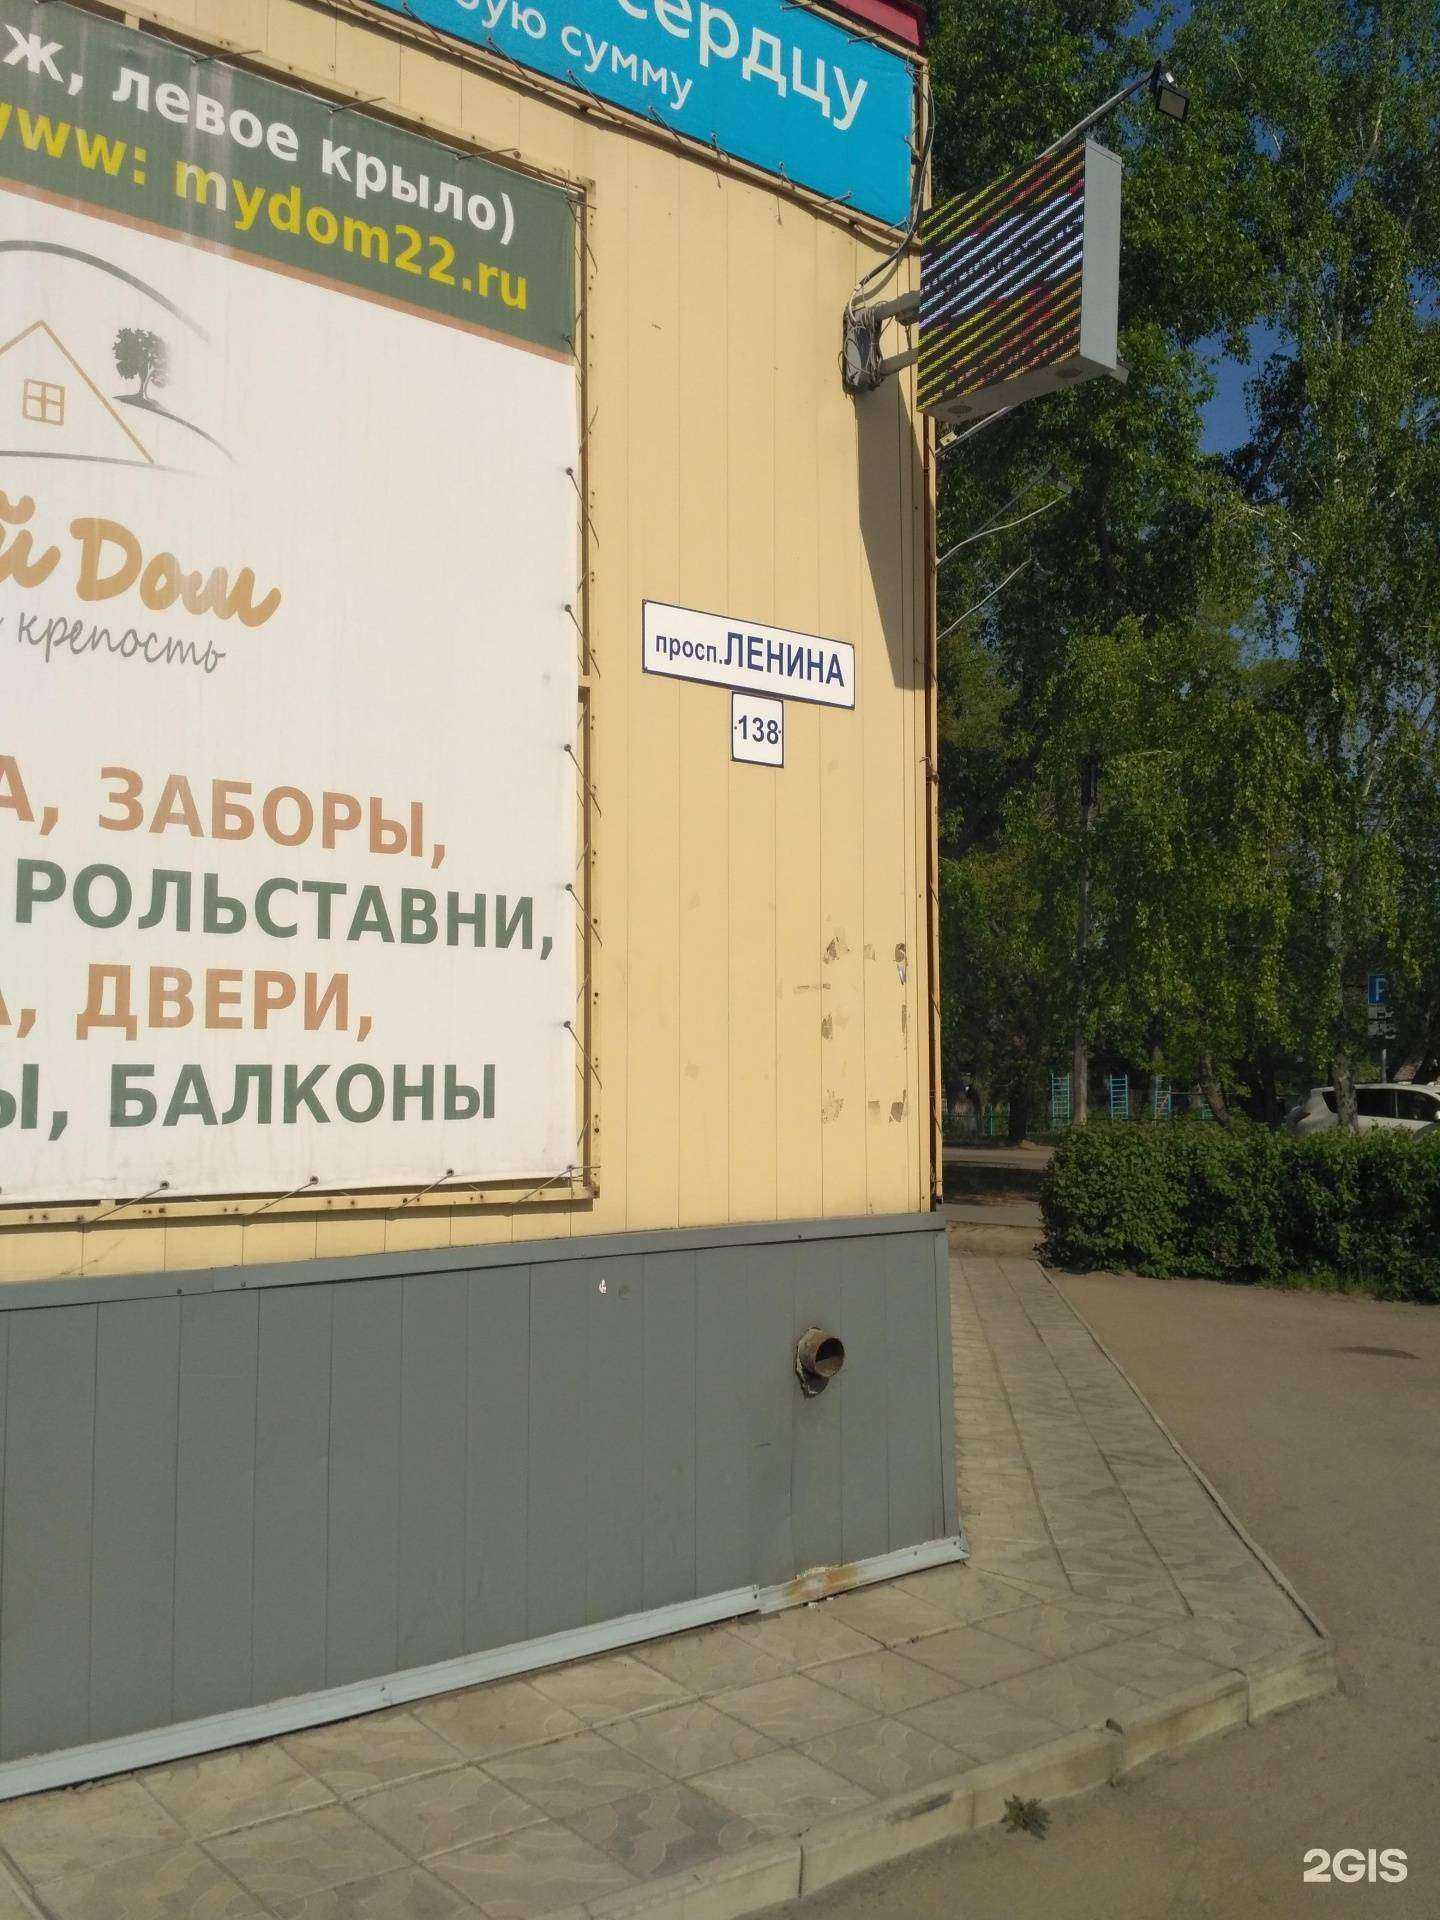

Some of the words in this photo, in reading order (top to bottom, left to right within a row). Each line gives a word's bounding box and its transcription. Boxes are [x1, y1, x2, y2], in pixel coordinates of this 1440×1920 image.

[561, 25, 693, 110] сумму
[112, 66, 299, 161] левое
[321, 138, 516, 246] крыло)
[0, 103, 147, 186] ww:
[175, 158, 529, 311] mydom22.ru
[18, 611, 226, 673] крепость
[738, 714, 779, 744] 138
[98, 766, 446, 869] ЗАБОРЫ,
[15, 858, 554, 960] РОЛЬСТАВНИ,
[75, 963, 373, 1042] ДВЕРИ,
[109, 1063, 496, 1128] БАЛКОНЫ
